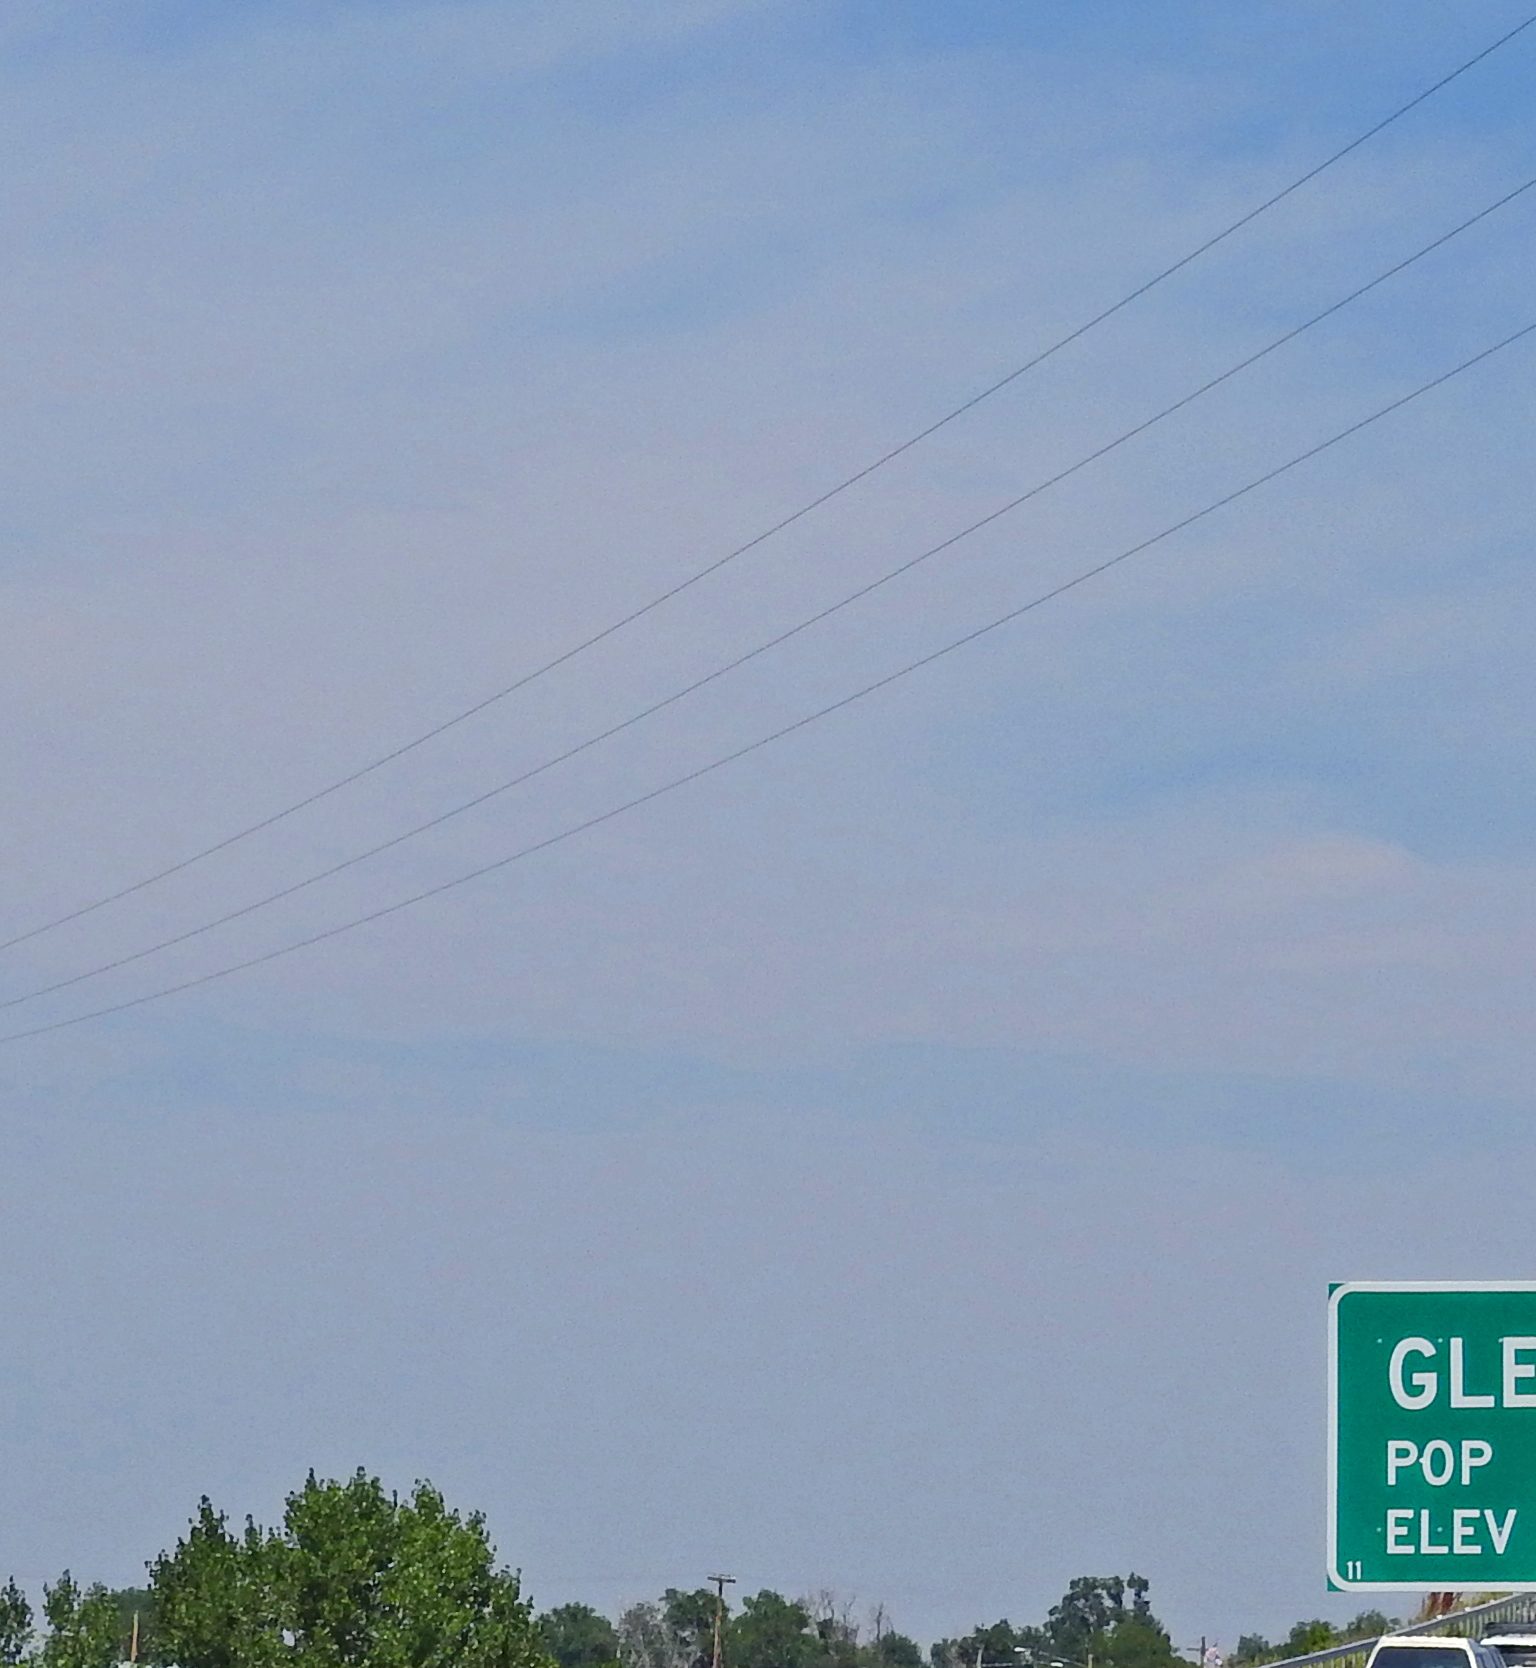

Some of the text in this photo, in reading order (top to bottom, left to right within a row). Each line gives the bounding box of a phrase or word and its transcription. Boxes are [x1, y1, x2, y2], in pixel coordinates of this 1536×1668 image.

[1386, 1439, 1493, 1486] POP
[1386, 1508, 1517, 1555] ELEV
[1346, 1560, 1362, 1580] 11
